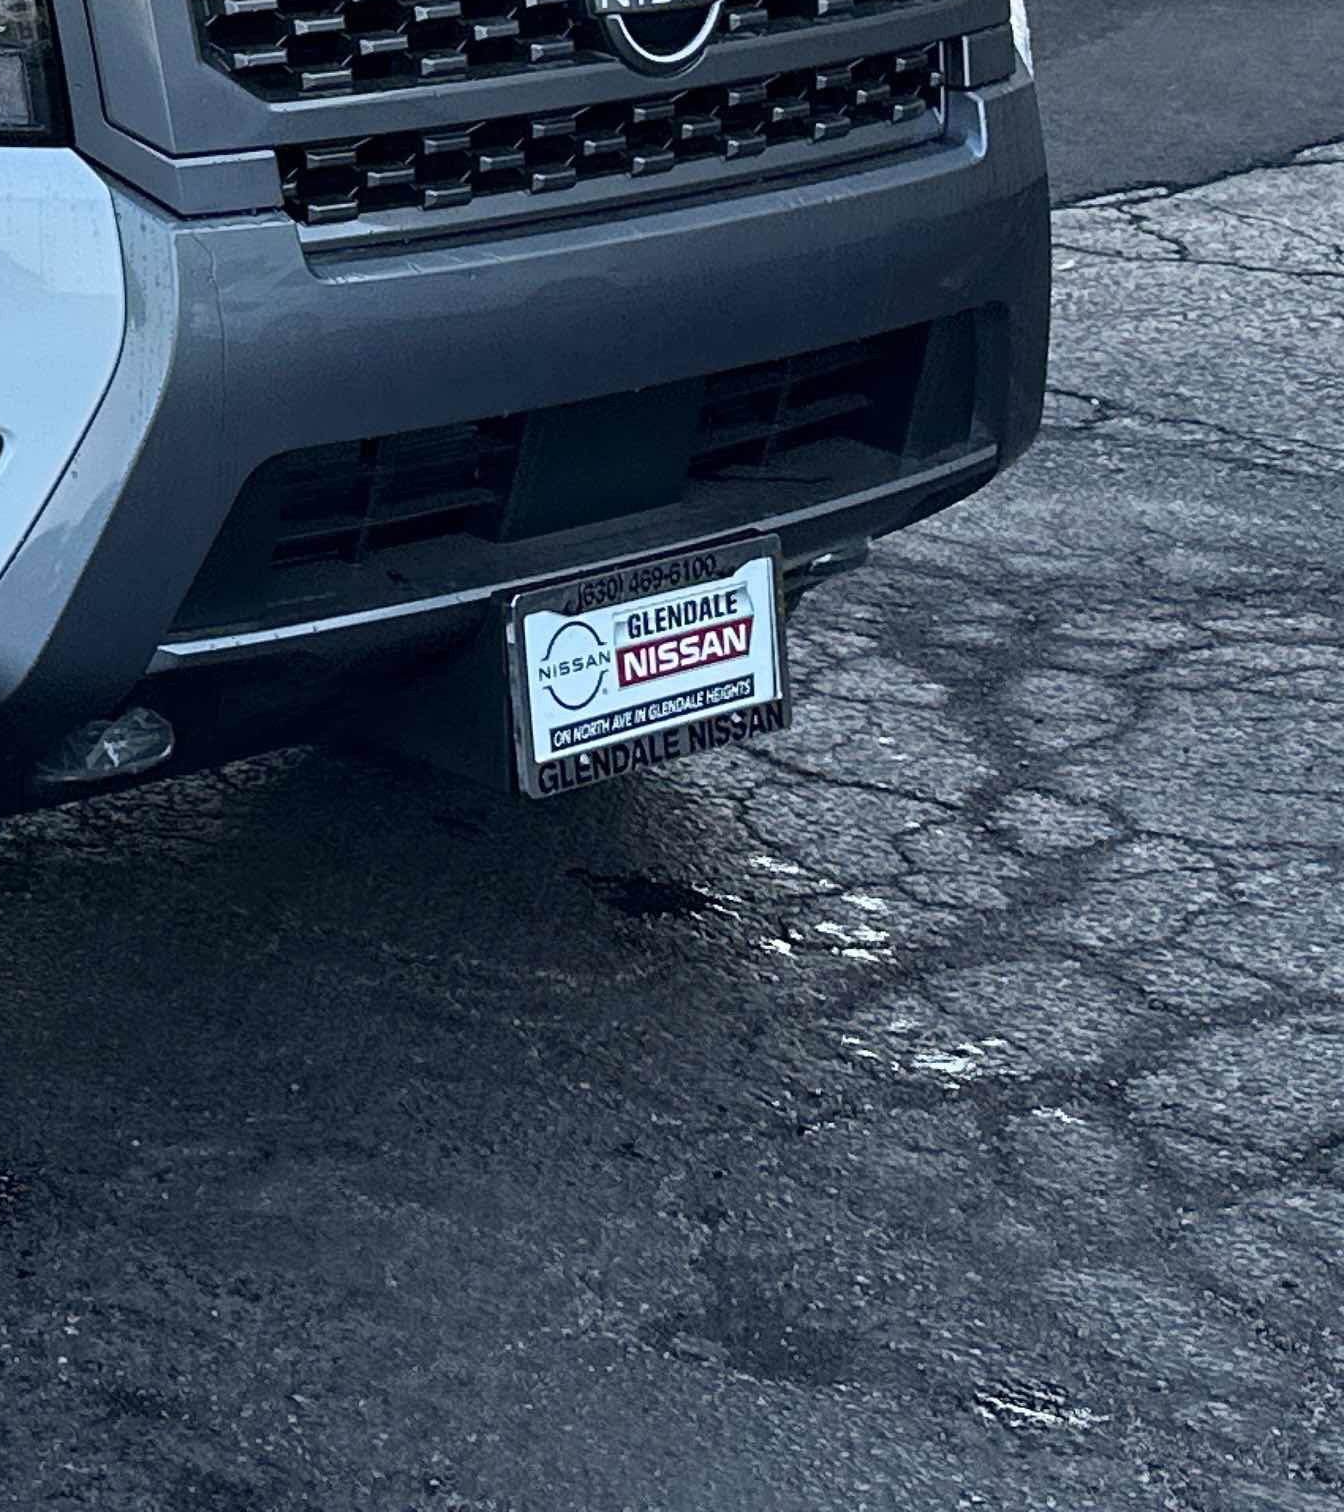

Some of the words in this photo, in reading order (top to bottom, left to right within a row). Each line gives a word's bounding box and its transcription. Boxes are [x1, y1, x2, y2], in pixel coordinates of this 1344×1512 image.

[627, 589, 738, 639] GLENDALE
[538, 650, 611, 682] NISSAN
[623, 624, 746, 681] NISSAN
[553, 730, 572, 747] ON
[573, 719, 611, 743] NORTH
[611, 712, 632, 731] AVE
[633, 707, 647, 724] IN
[648, 693, 704, 720] GLENDALE
[706, 678, 752, 703] HEIGHTS
[538, 729, 682, 795] GLENDALE
[687, 701, 785, 754] NISSAN
